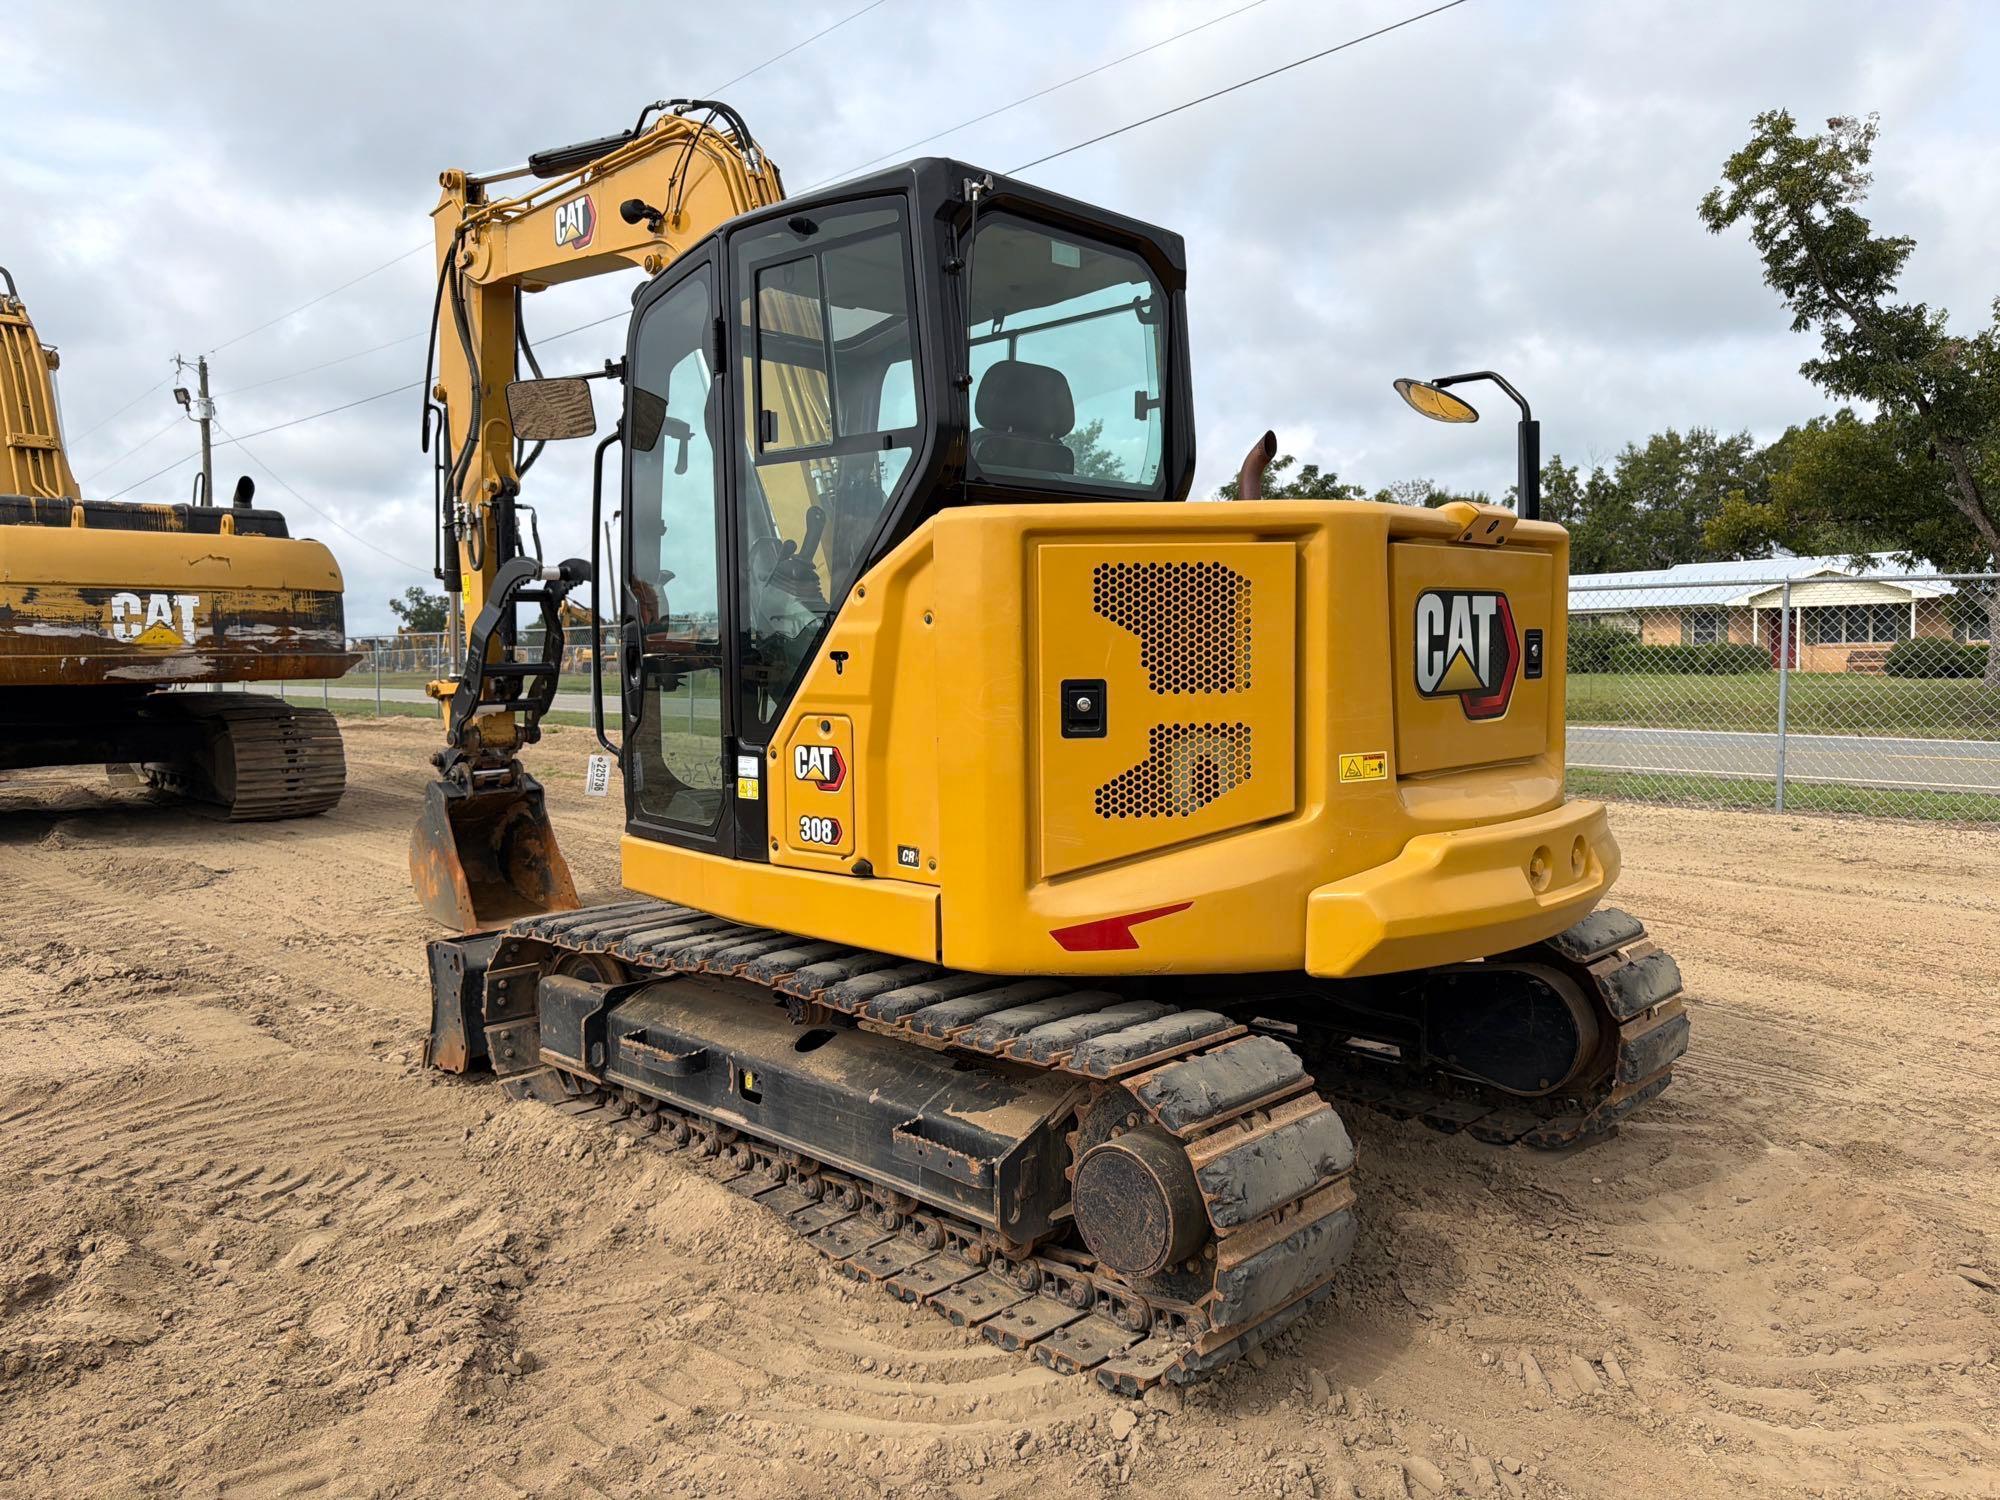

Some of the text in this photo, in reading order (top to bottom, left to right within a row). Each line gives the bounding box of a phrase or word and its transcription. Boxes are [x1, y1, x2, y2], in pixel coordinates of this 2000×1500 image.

[555, 196, 586, 245] CAT
[111, 592, 200, 645] CAT
[1416, 593, 1497, 692] CAT
[593, 763, 607, 792] 225736
[794, 746, 833, 780] CAT
[800, 817, 832, 844] 308
[902, 849, 915, 863] CR
